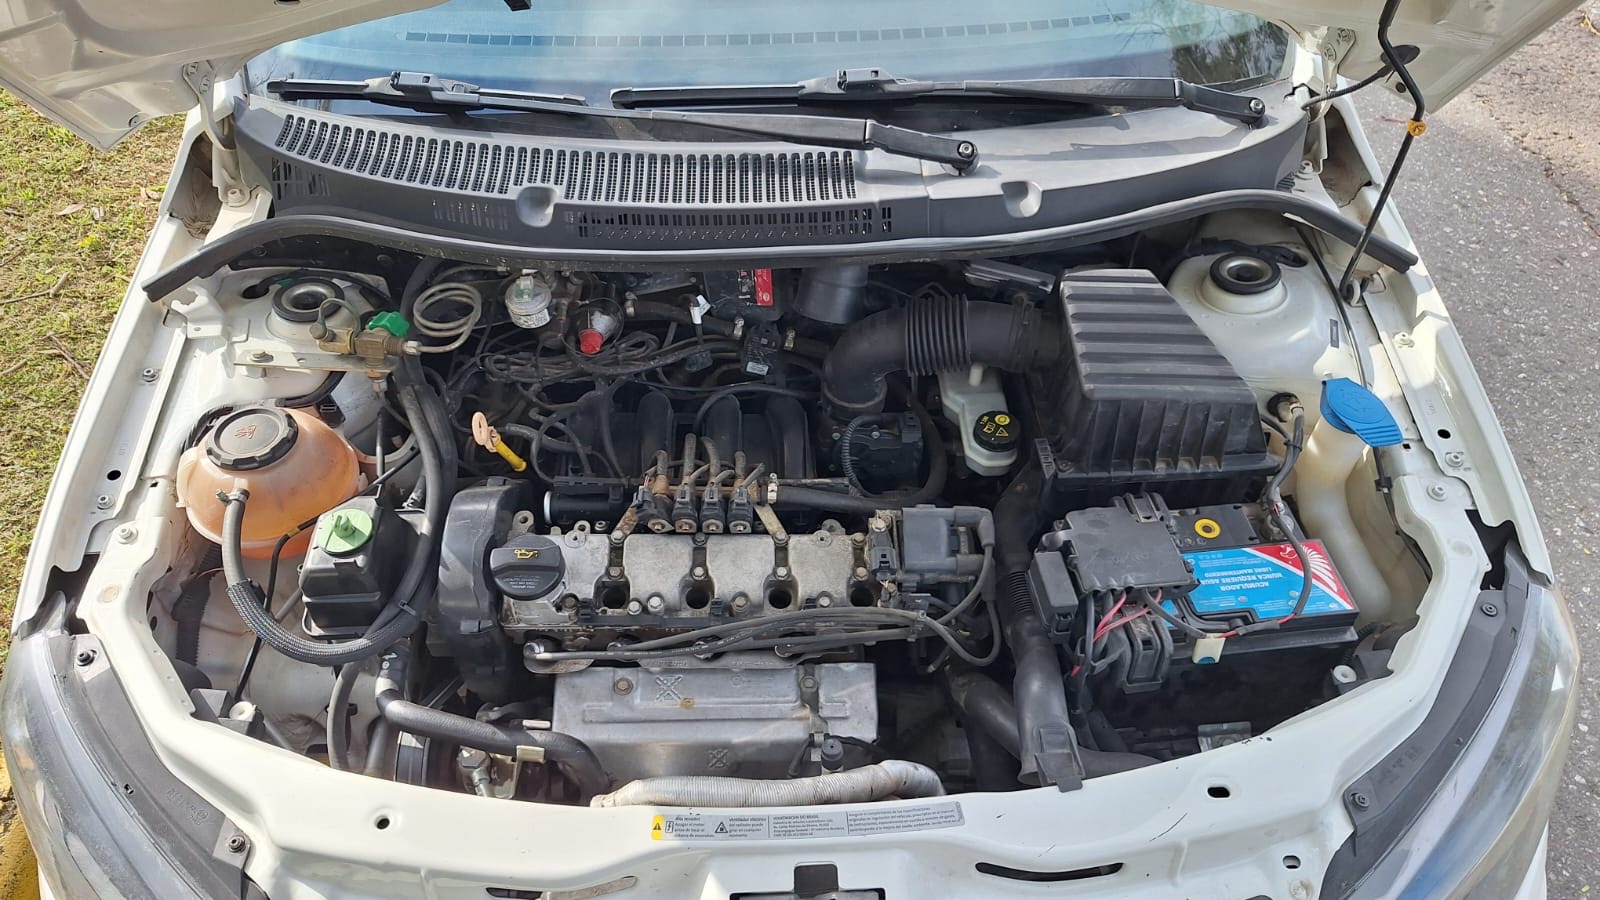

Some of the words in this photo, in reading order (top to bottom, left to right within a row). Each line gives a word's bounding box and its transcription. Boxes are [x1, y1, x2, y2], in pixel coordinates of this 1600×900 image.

[1221, 575, 1256, 583] REQUIERE
[1256, 572, 1283, 581] NUNCA
[1220, 581, 1269, 591] ACUMULADOR
